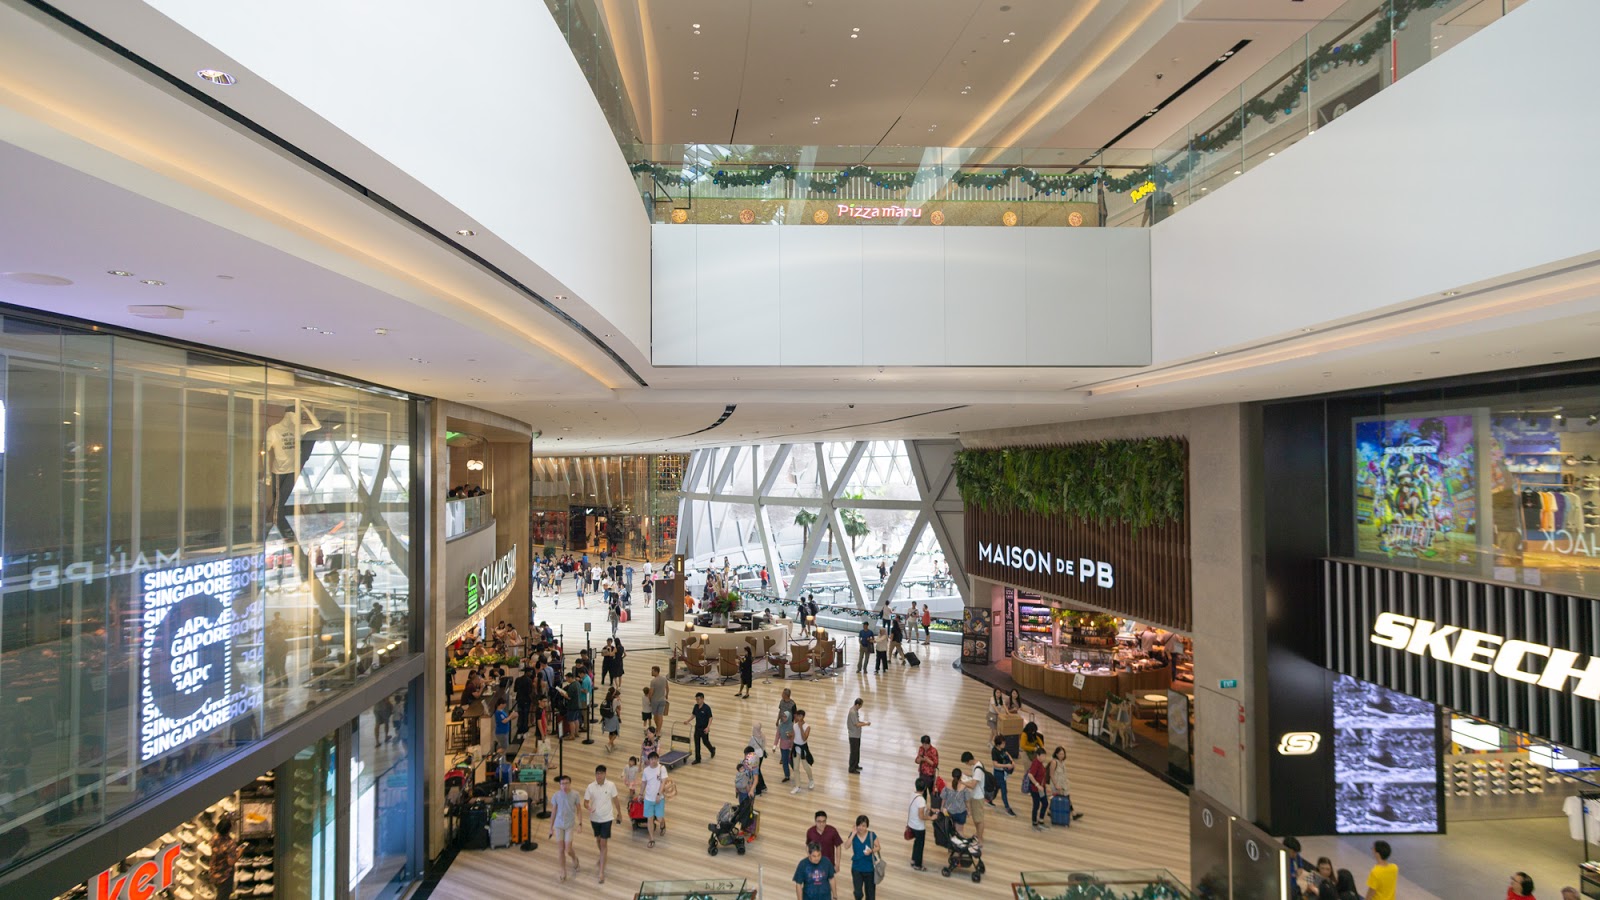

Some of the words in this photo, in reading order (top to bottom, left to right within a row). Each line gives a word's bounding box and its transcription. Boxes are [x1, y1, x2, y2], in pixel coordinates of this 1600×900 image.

[1384, 445, 1438, 454] SKECHERS
[144, 559, 232, 591] SINGAPORE
[978, 541, 1051, 576] MAISON
[1056, 558, 1074, 576] DE
[1079, 557, 1114, 589] PB
[144, 575, 232, 609] SINGAPORE
[1370, 612, 1600, 701] SKECH
[142, 705, 231, 761] SINGAPORE
